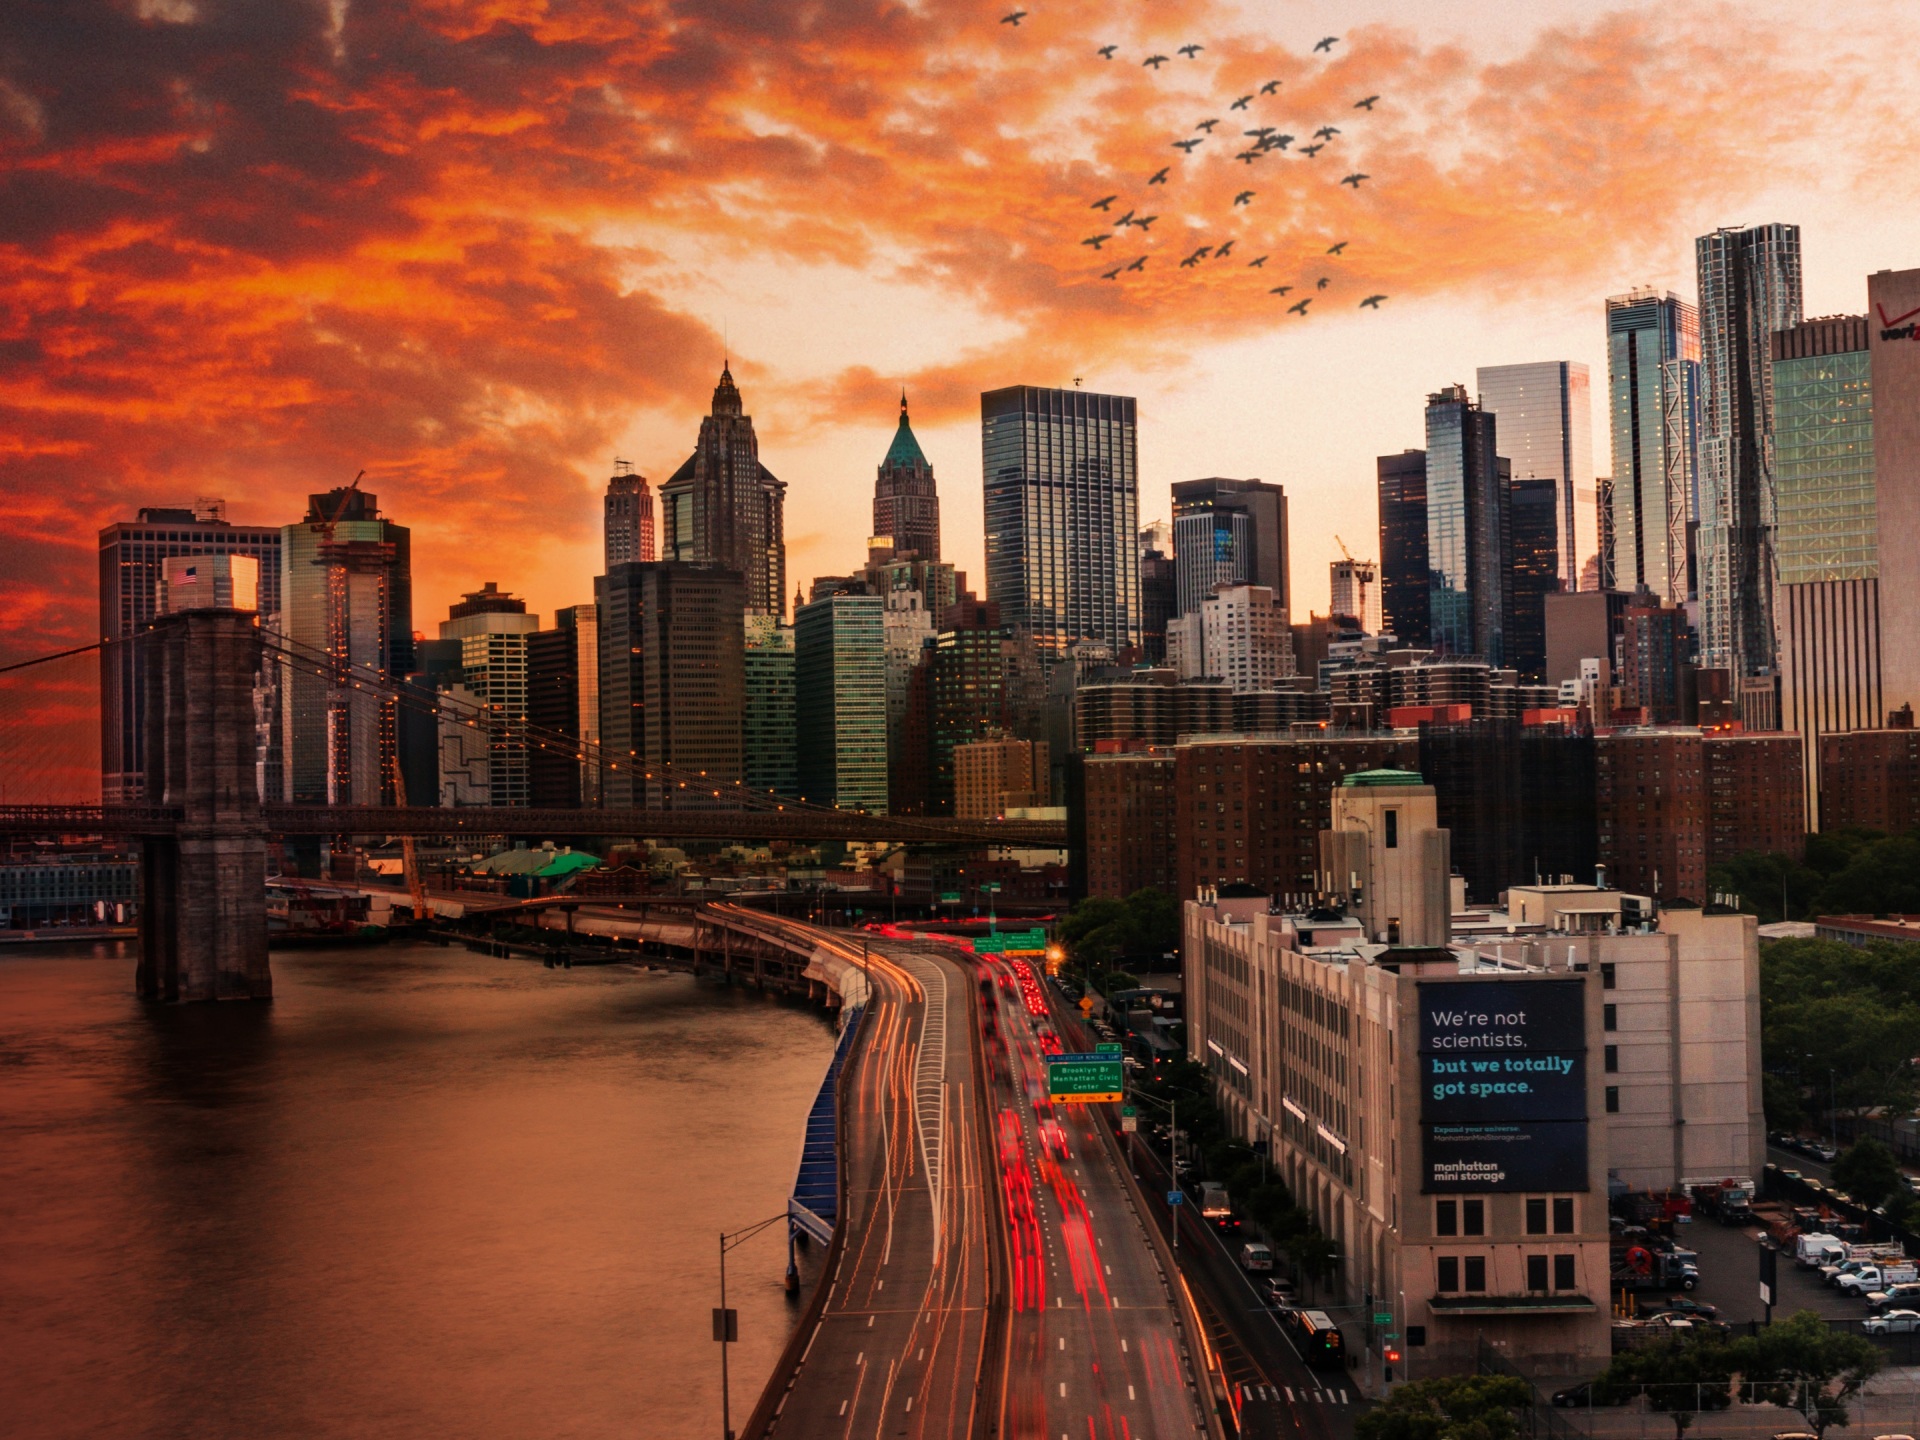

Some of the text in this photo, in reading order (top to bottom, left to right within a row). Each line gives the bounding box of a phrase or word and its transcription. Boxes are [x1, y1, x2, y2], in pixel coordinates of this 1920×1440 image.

[1432, 1011, 1526, 1026] We're not
[1432, 1032, 1527, 1048] scientists,
[1432, 1056, 1574, 1075] but we totally
[1433, 1081, 1533, 1100] got space.
[1433, 1126, 1464, 1134] Expand
[1433, 1134, 1532, 1142] ManhattanMiniStorage.com
[1434, 1159, 1498, 1172] manhattan
[1434, 1171, 1505, 1183] mini storage
